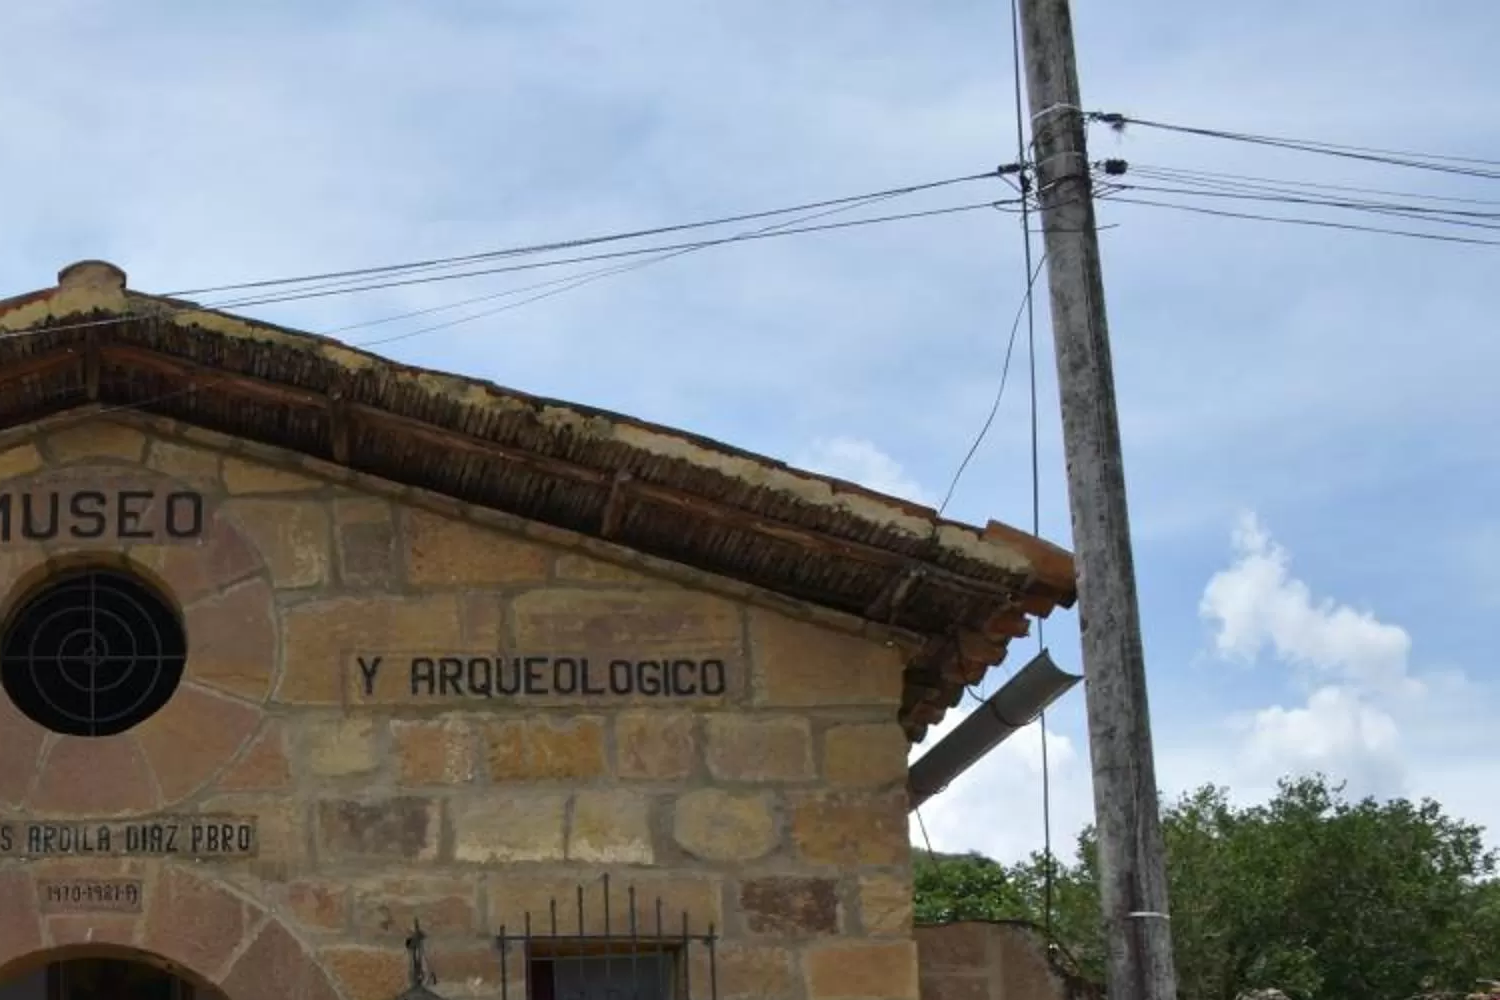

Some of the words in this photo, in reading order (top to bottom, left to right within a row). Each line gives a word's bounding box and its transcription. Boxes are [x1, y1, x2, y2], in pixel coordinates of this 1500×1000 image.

[357, 656, 383, 696] Y
[410, 657, 727, 699] ARQUEOLOGICO
[125, 823, 179, 853] DIAZ
[190, 823, 250, 854] PBRO
